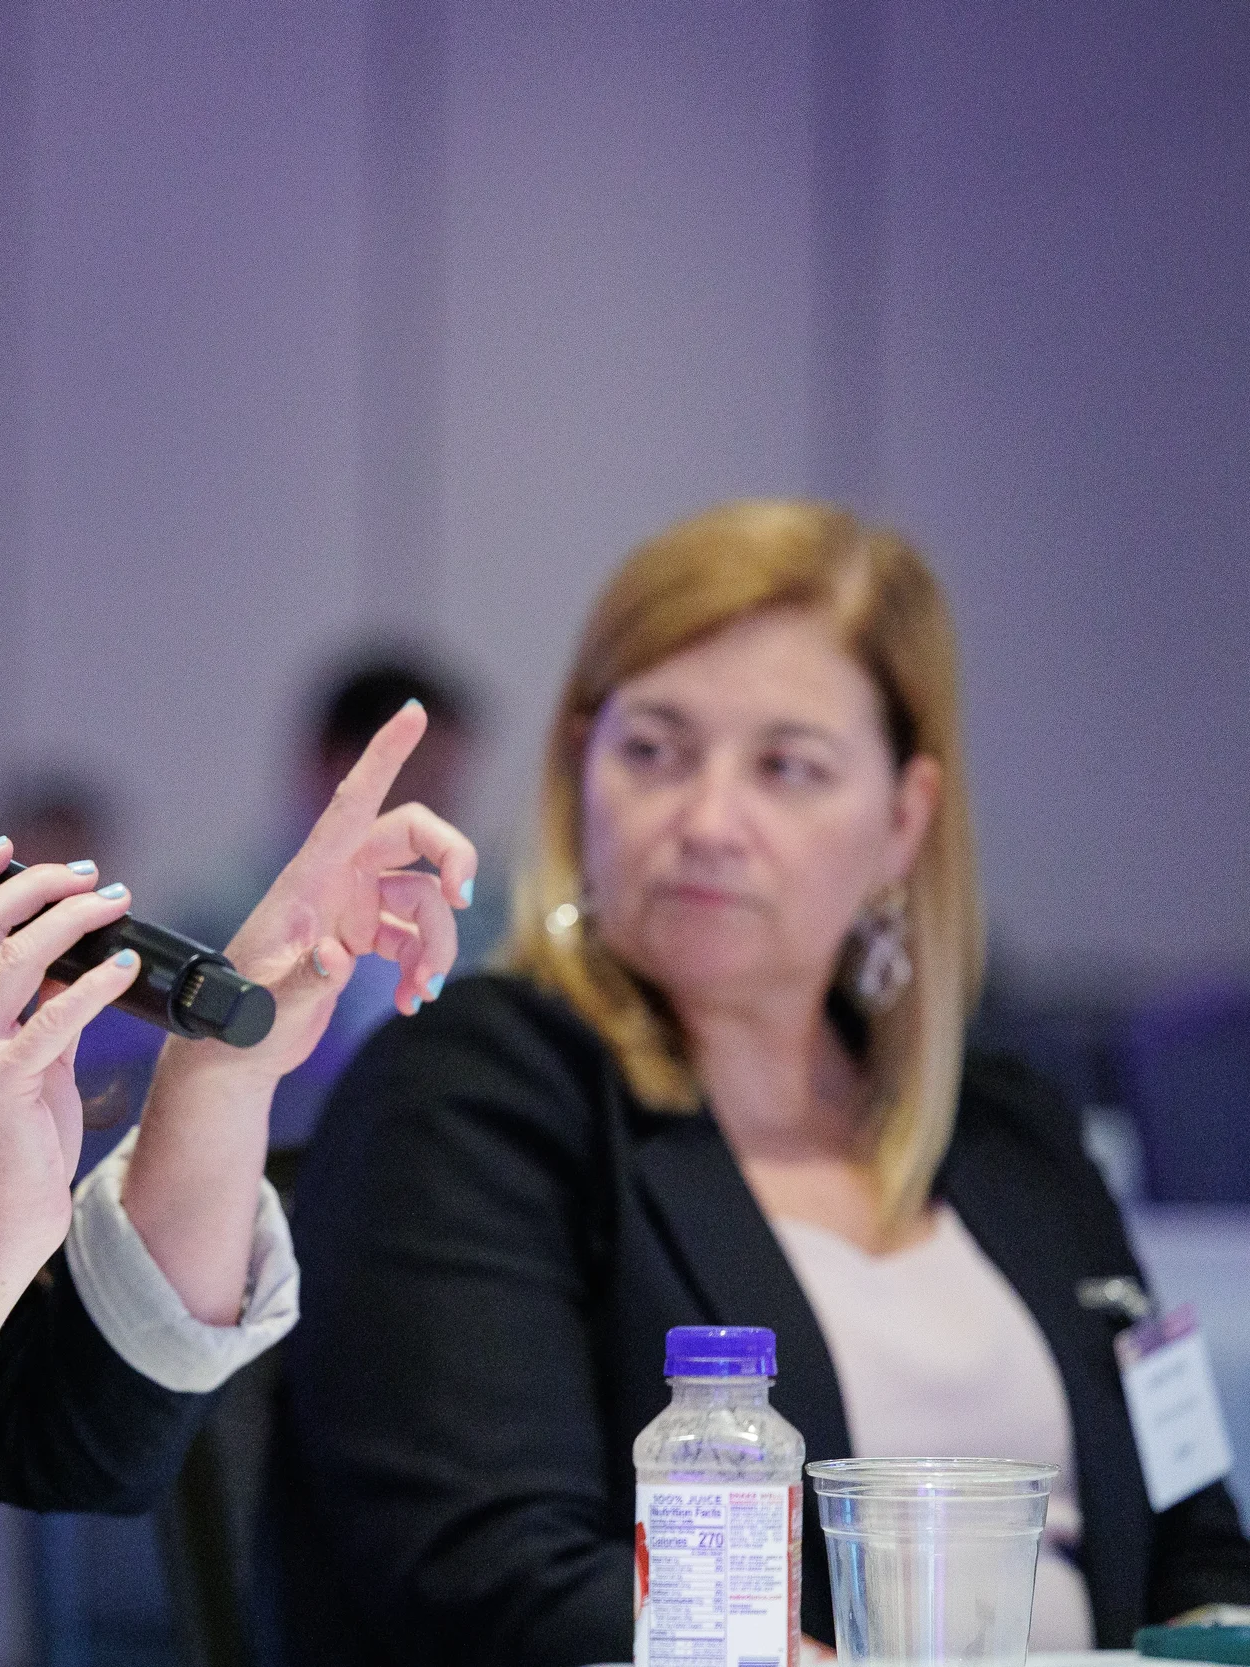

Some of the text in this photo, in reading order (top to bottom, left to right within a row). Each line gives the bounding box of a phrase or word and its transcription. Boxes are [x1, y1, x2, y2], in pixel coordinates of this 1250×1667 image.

[653, 1495, 683, 1505] 100%
[687, 1495, 722, 1505] JUICE
[651, 1506, 721, 1517] Nutrition Facts
[650, 1532, 723, 1548] Calories 270
